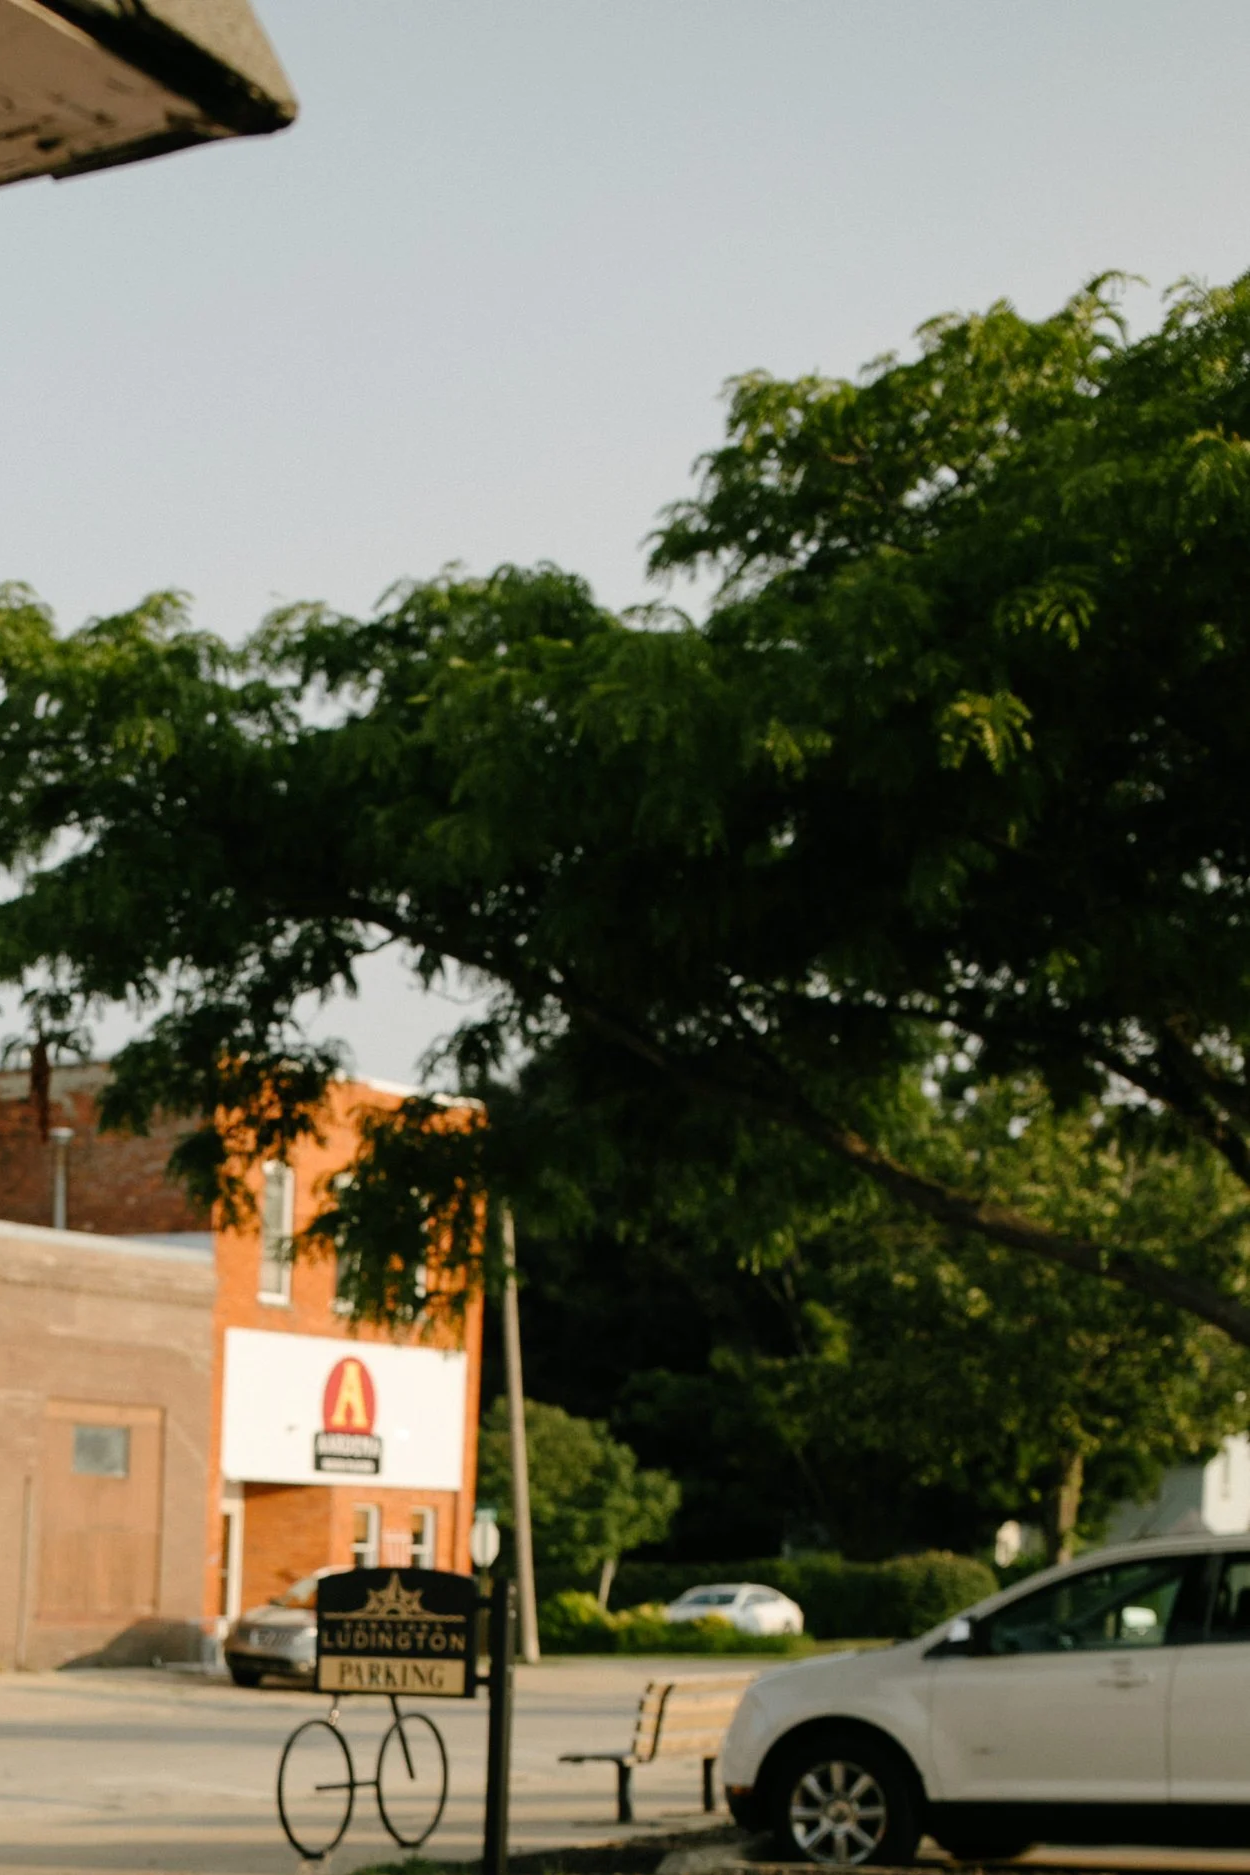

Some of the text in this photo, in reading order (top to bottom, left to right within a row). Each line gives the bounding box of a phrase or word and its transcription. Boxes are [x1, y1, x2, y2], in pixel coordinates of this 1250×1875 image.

[331, 1360, 368, 1427] A
[321, 1630, 466, 1652] LUDINGTON
[339, 1661, 445, 1688] PARKING
